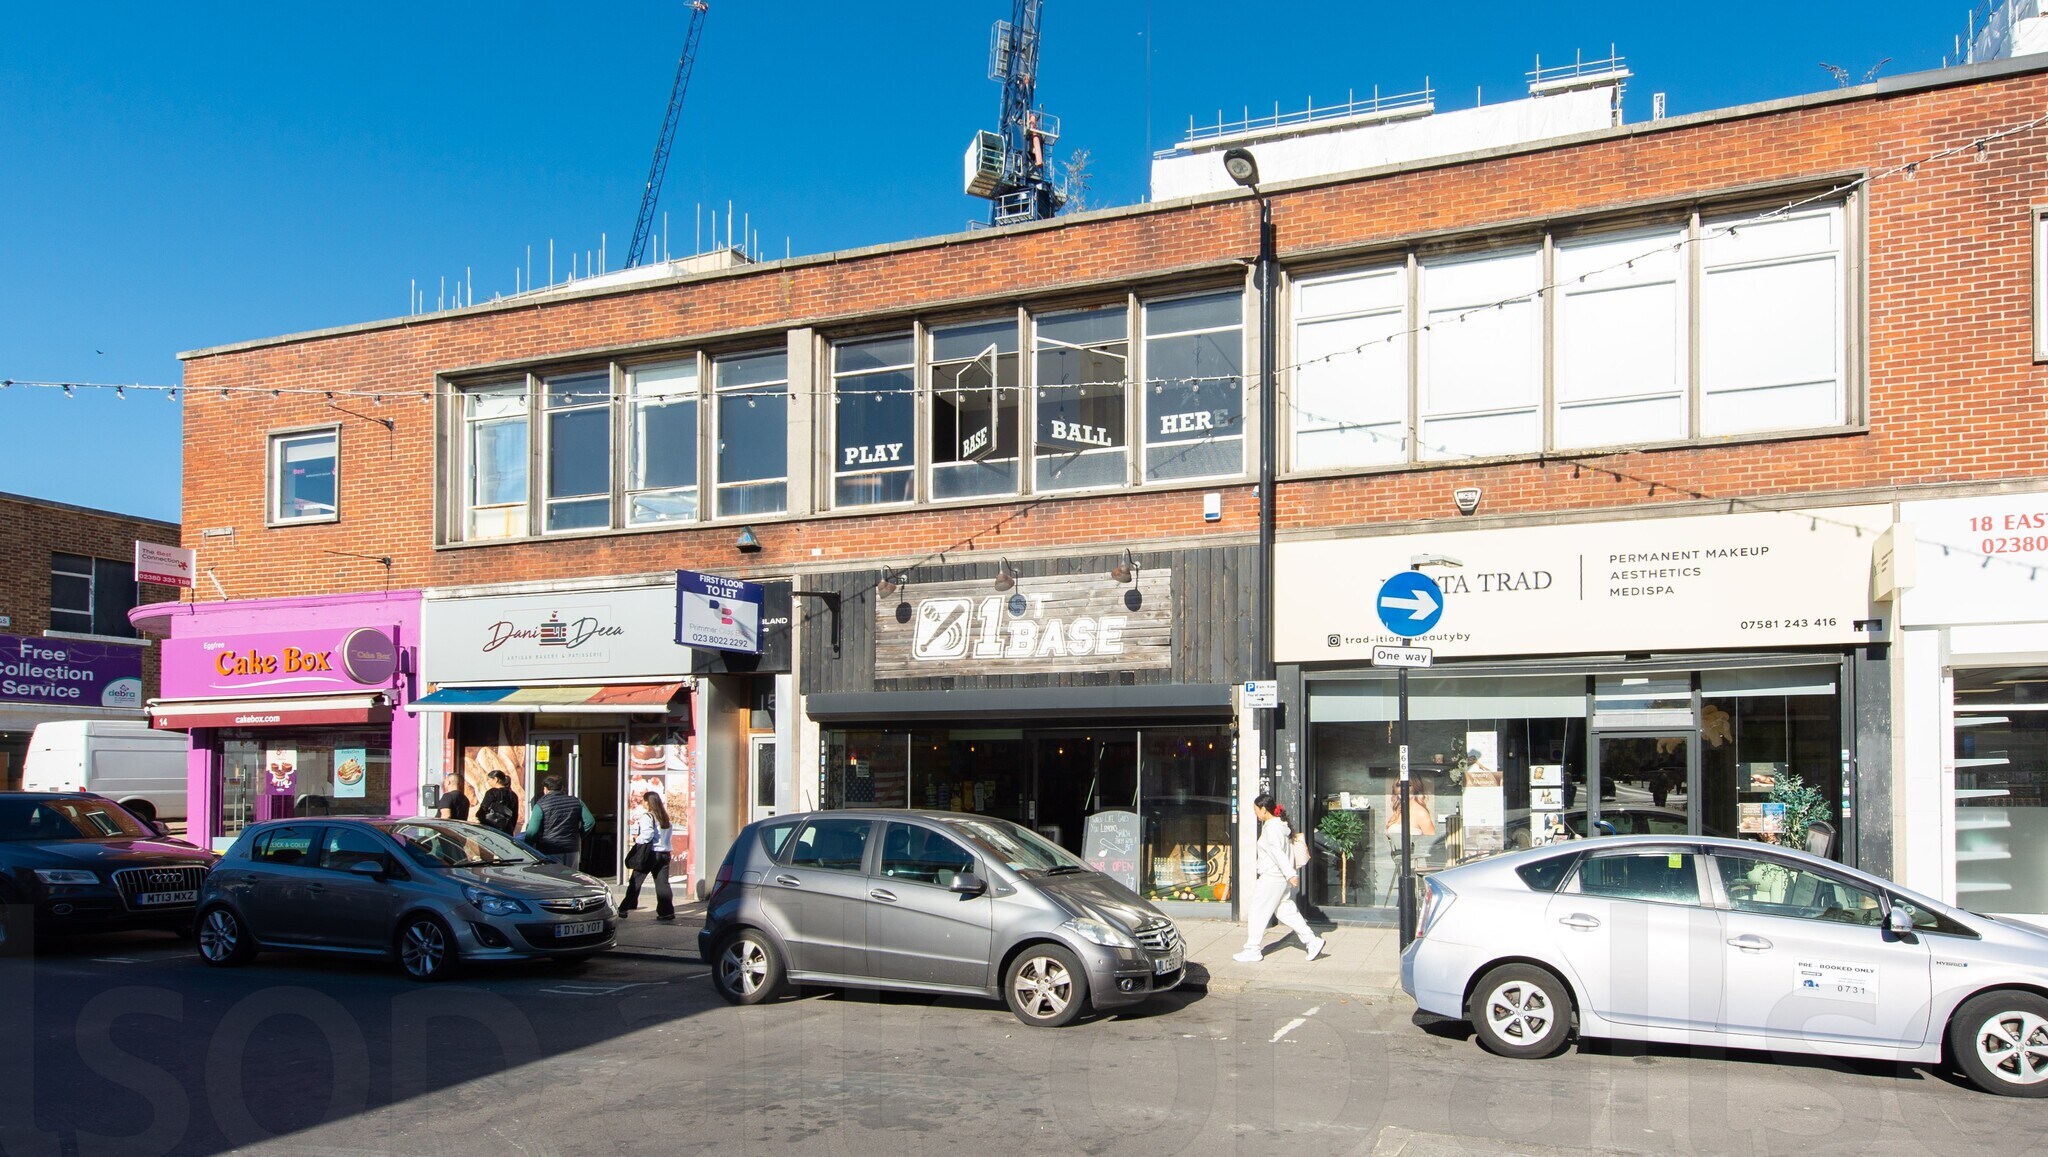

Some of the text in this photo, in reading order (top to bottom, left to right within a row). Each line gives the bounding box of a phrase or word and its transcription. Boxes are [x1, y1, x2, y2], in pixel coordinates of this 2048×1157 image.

[1160, 409, 1228, 434] HERE
[1051, 420, 1111, 446] BALL
[963, 427, 987, 458] BASE
[845, 443, 902, 464] PLAY
[1970, 513, 2048, 531] 18 EAS
[1982, 535, 2048, 554] 02380
[142, 554, 180, 564] Connection
[157, 550, 172, 558] Best
[1609, 545, 1770, 564] PERMANENT MAKEUP
[1610, 566, 1701, 581] AESTHETICS
[700, 574, 744, 589] FIRST FLOOR
[1478, 570, 1552, 594] TRAD
[706, 585, 738, 598] TO LET
[1609, 585, 1675, 598] MEDISPA
[1740, 616, 1837, 630] 07581 243 416
[483, 617, 624, 652] Dani Deea
[692, 633, 748, 648] 023 8022 2292
[1004, 616, 1128, 658] BASE
[20, 644, 66, 662] Free
[1378, 650, 1427, 663] One way
[216, 646, 334, 677] Cake Box
[0, 662, 94, 681] ollection
[2, 679, 80, 698] Service
[108, 690, 136, 698] debra
[159, 718, 168, 726] 14
[235, 714, 280, 724] cakebox.com
[1112, 861, 1134, 872] OPEN
[148, 892, 194, 903] MT13 MXZ
[564, 924, 584, 935] DY13
[1820, 964, 1852, 972] BOOKED
[1837, 985, 1865, 994] 0731
